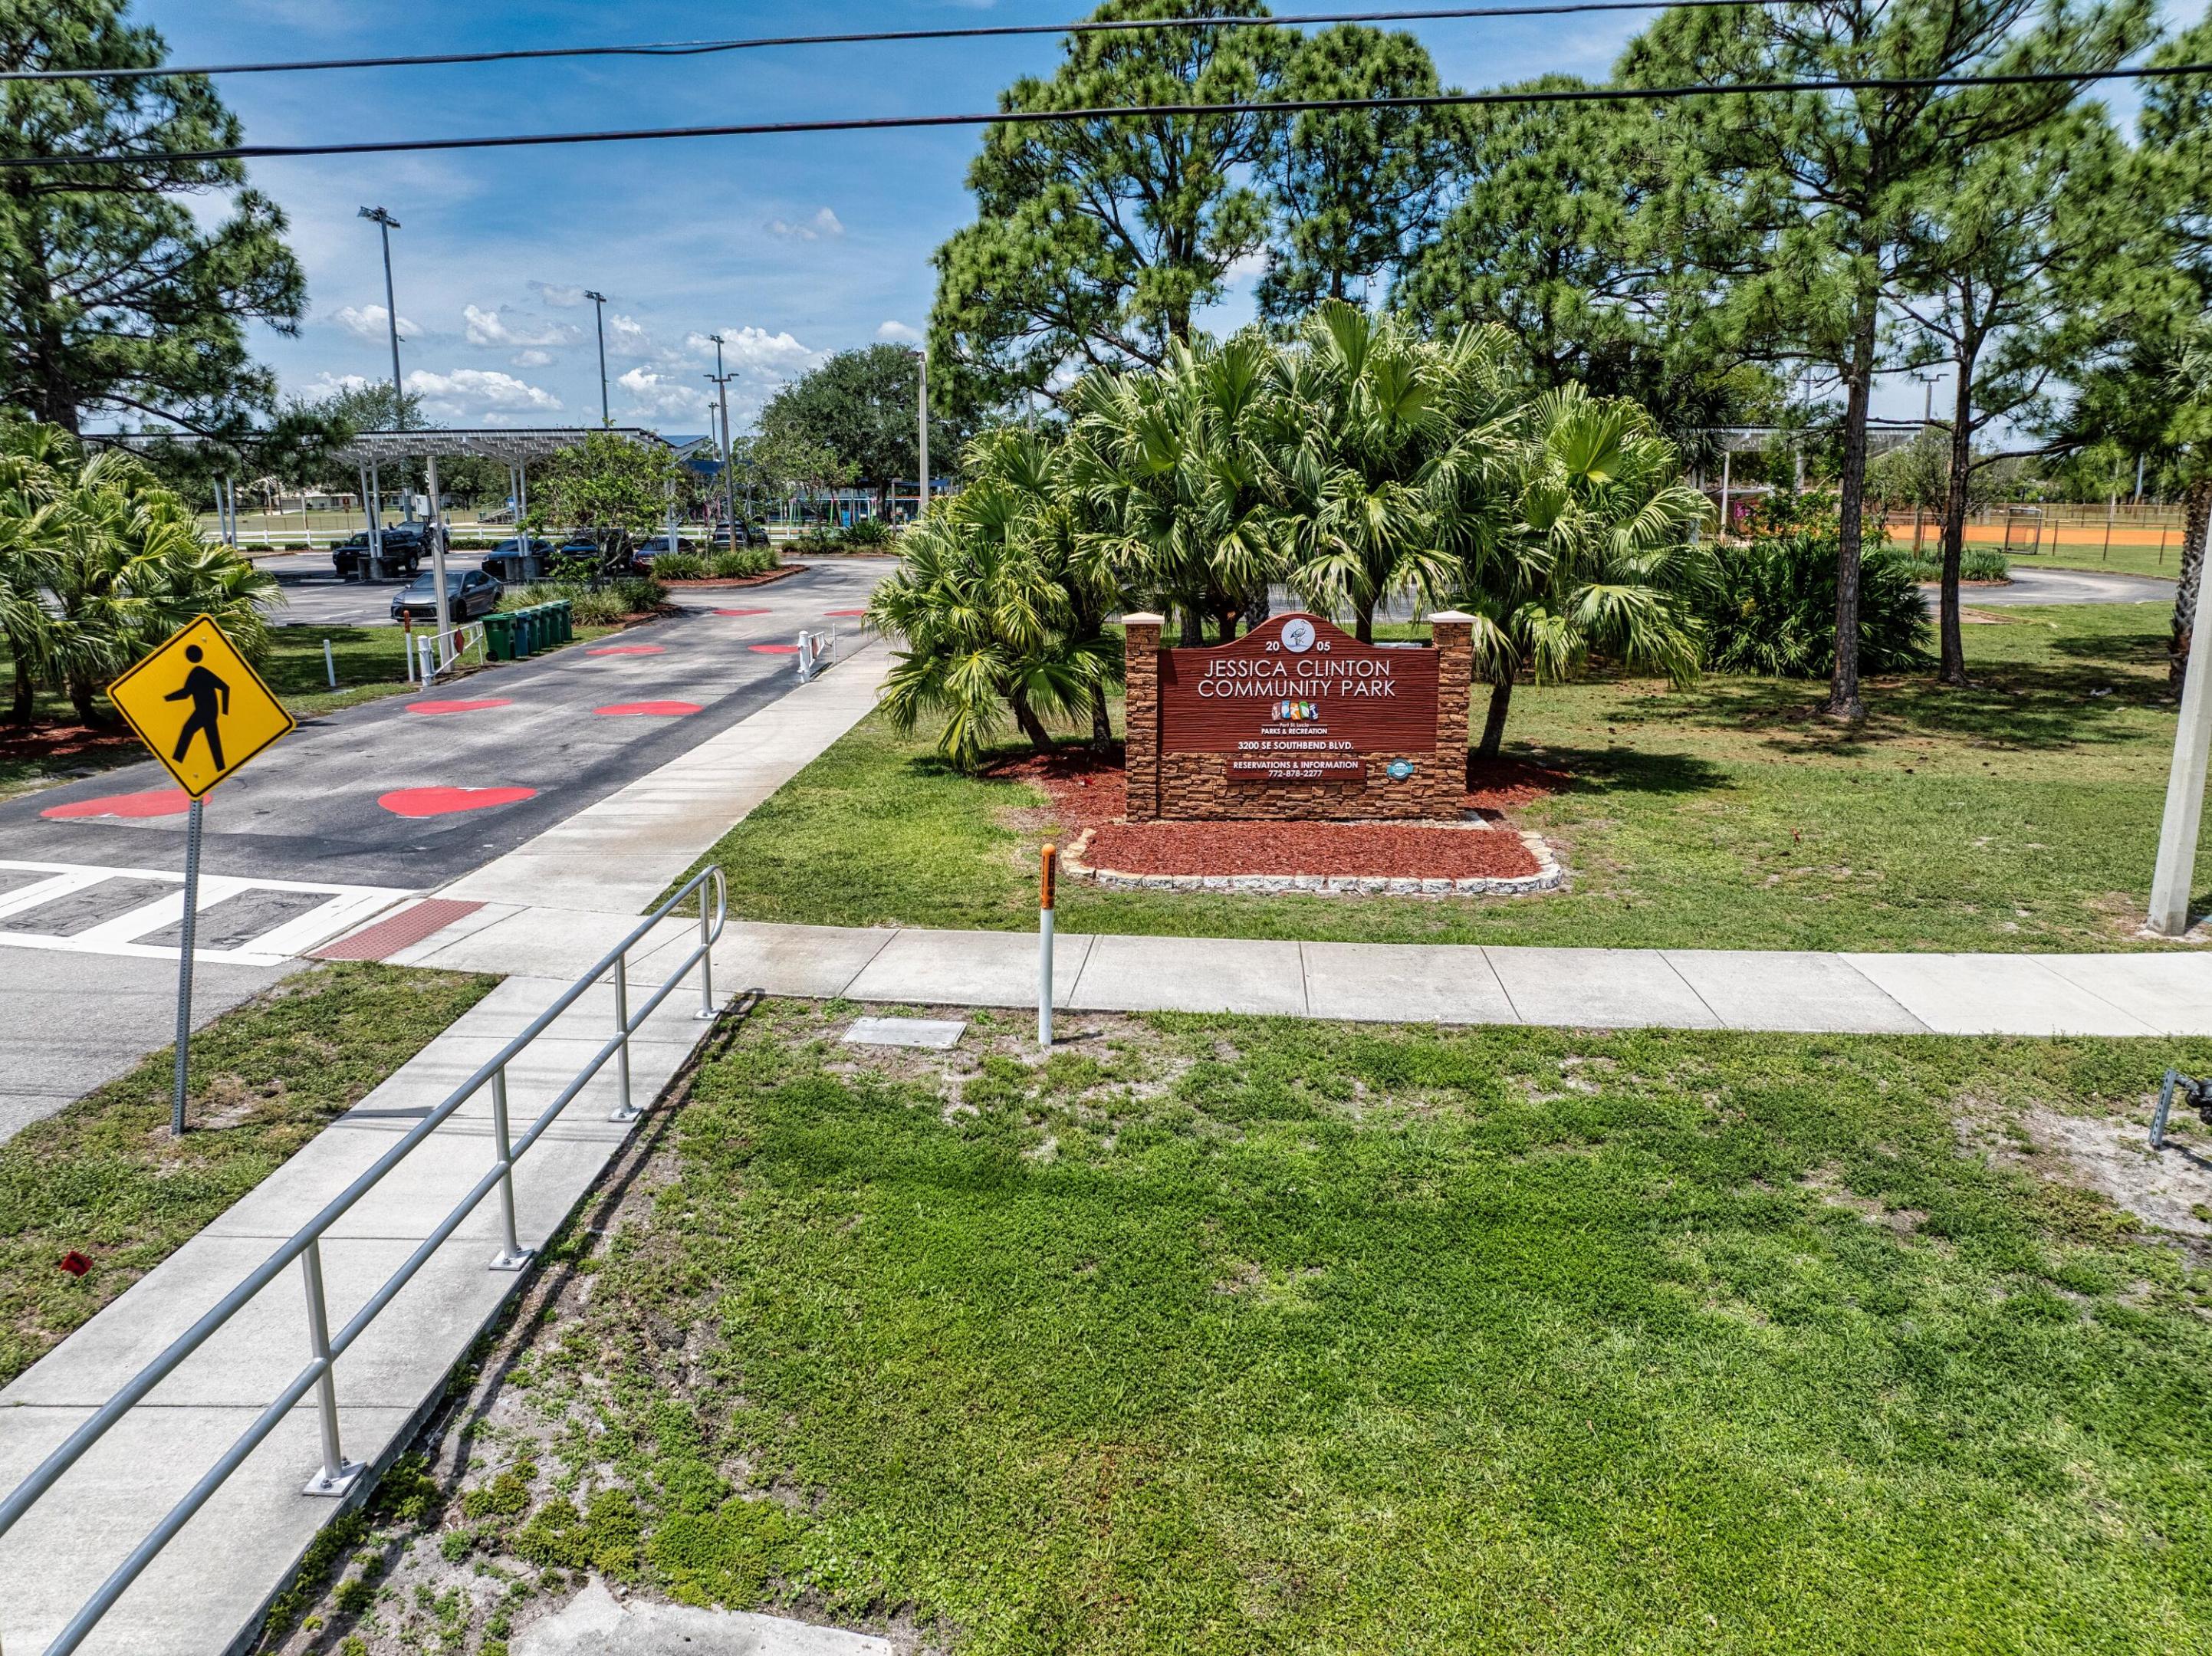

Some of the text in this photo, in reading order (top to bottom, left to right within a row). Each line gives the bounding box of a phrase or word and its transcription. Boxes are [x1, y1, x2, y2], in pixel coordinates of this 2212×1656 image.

[1265, 641, 1331, 652] 20 05
[1204, 659, 1390, 677] JESSICA CLINTON
[1198, 679, 1395, 697] COMMUNITY PARK
[1237, 741, 1354, 750] 3200 SE SOUTHBEND BLVD.
